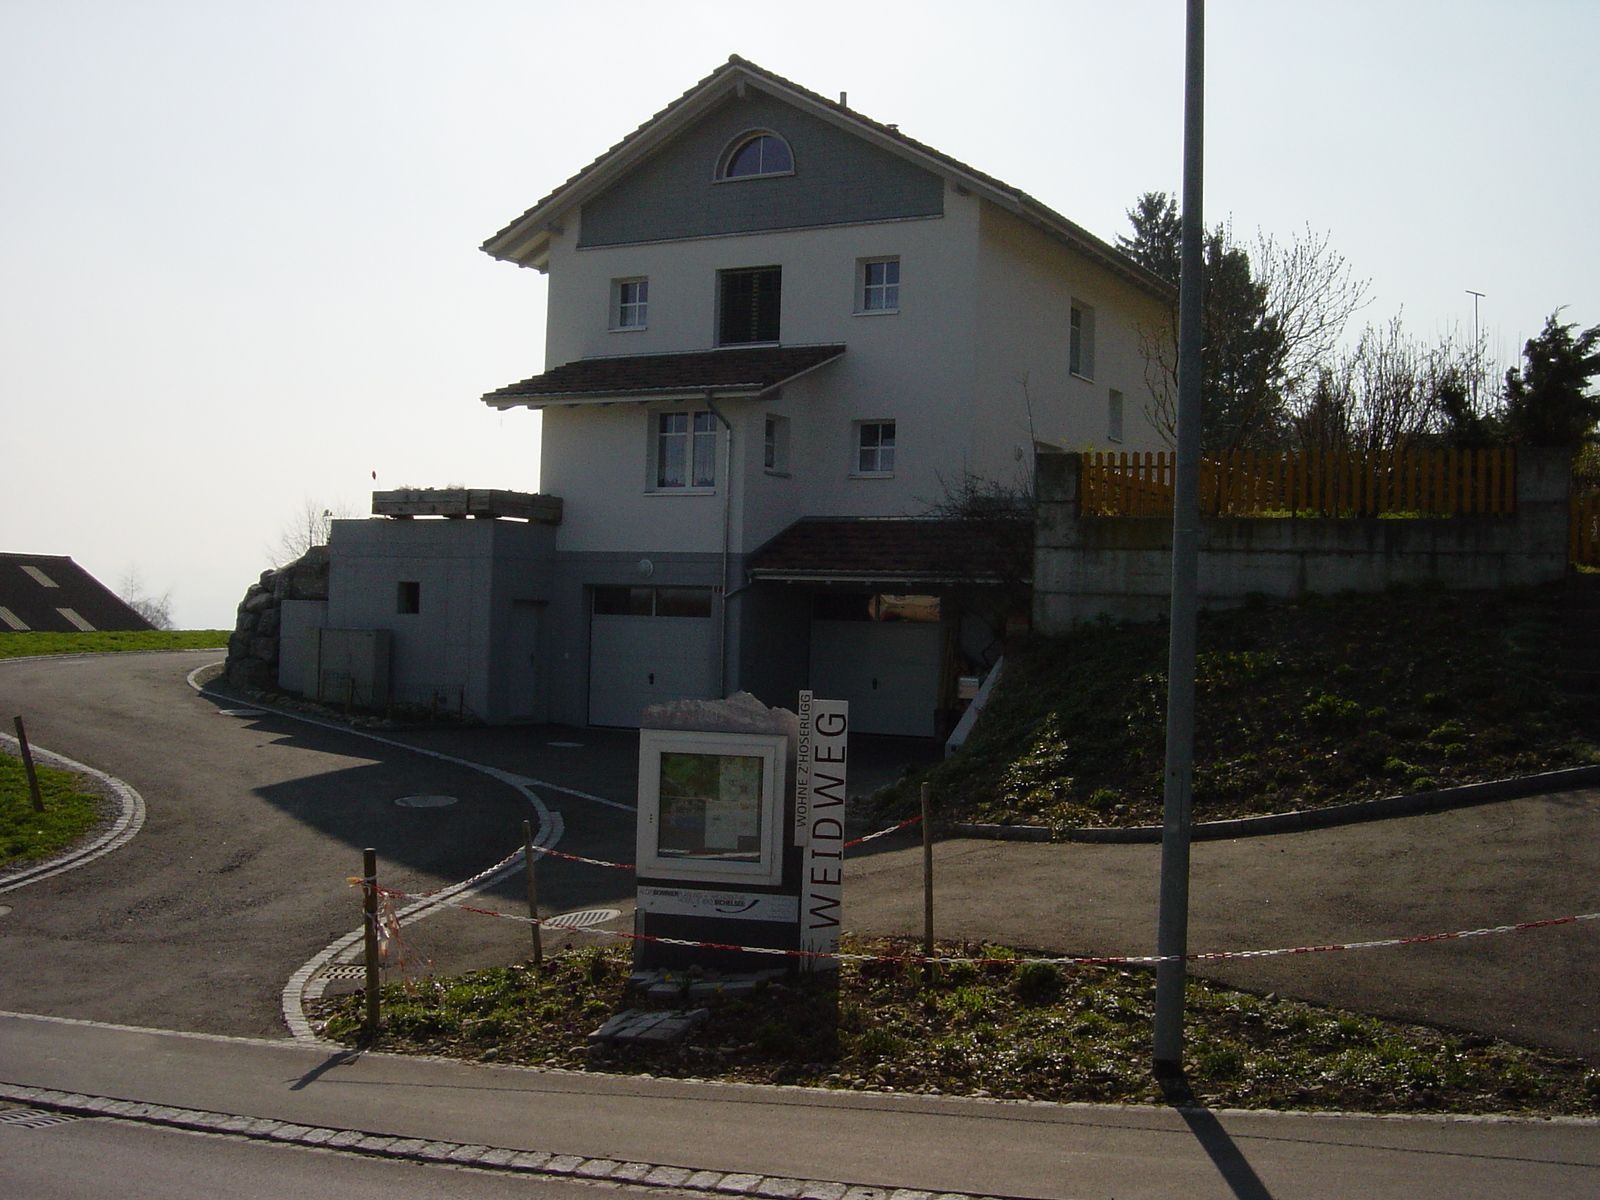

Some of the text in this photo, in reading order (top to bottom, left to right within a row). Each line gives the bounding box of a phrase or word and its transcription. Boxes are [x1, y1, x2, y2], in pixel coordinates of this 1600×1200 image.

[796, 694, 811, 827] WOHNE Z'HOSERUGG
[809, 713, 847, 929] WEIDWEG
